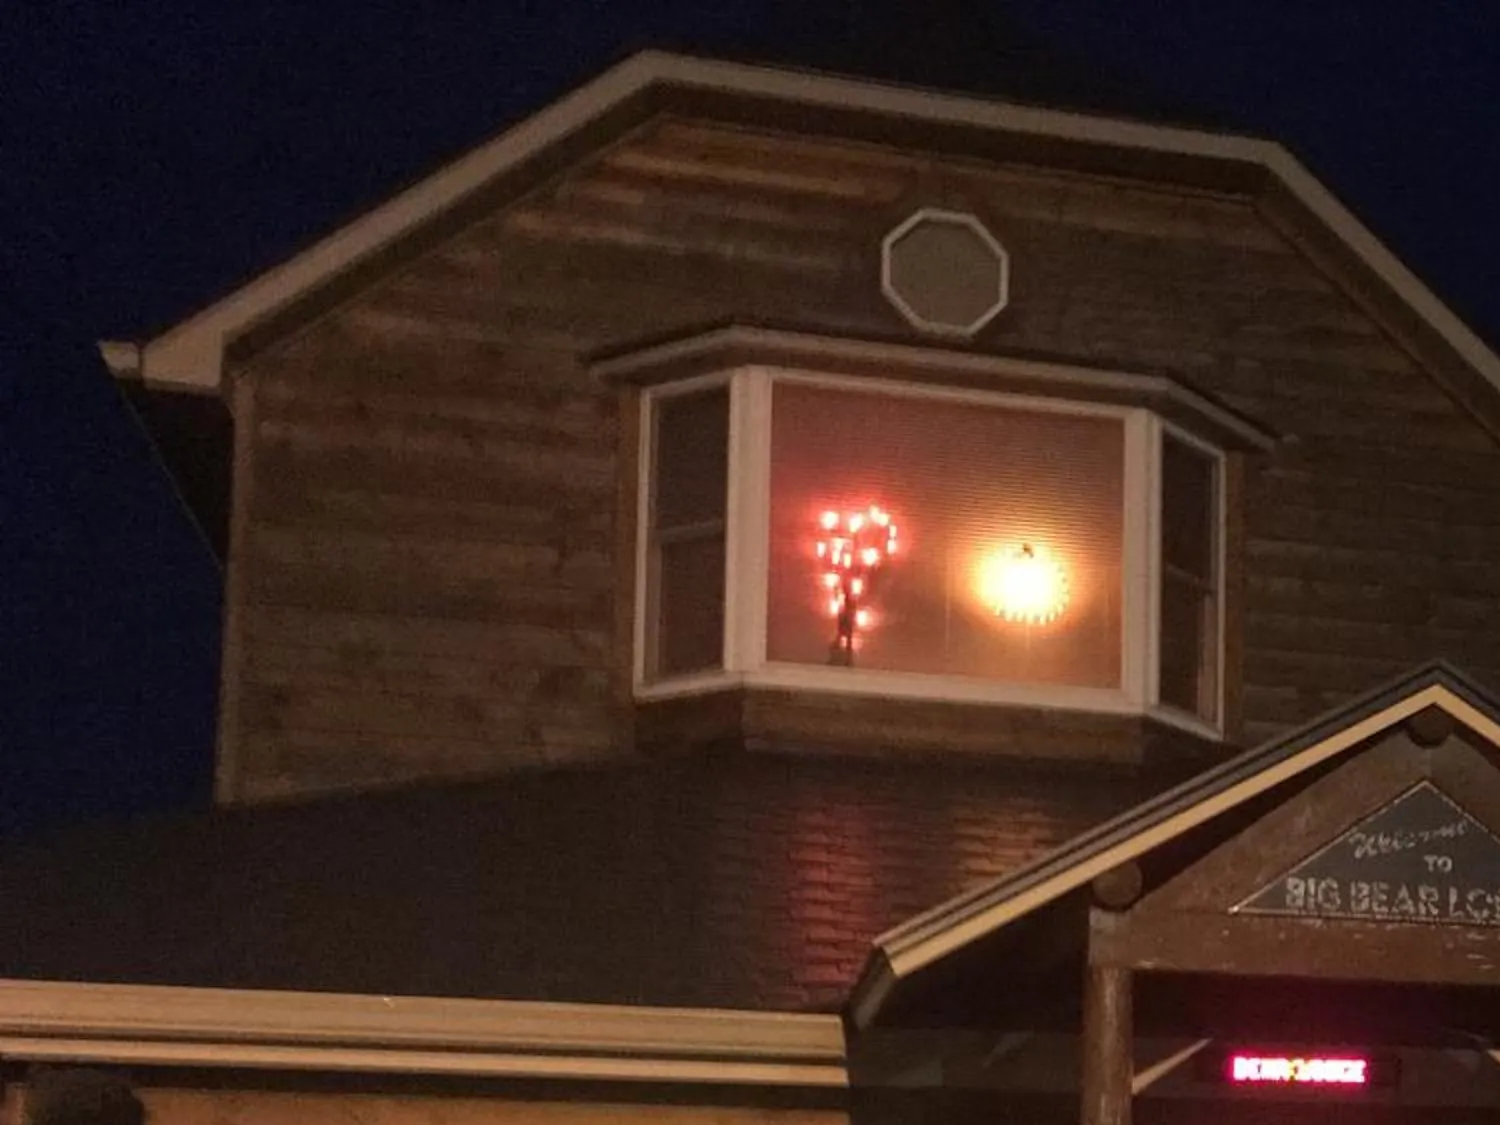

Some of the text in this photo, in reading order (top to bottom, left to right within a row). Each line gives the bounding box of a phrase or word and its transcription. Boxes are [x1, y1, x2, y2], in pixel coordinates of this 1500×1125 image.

[1423, 854, 1453, 872] TO
[1286, 876, 1342, 911] BIG
[1351, 880, 1439, 915] BEAR
